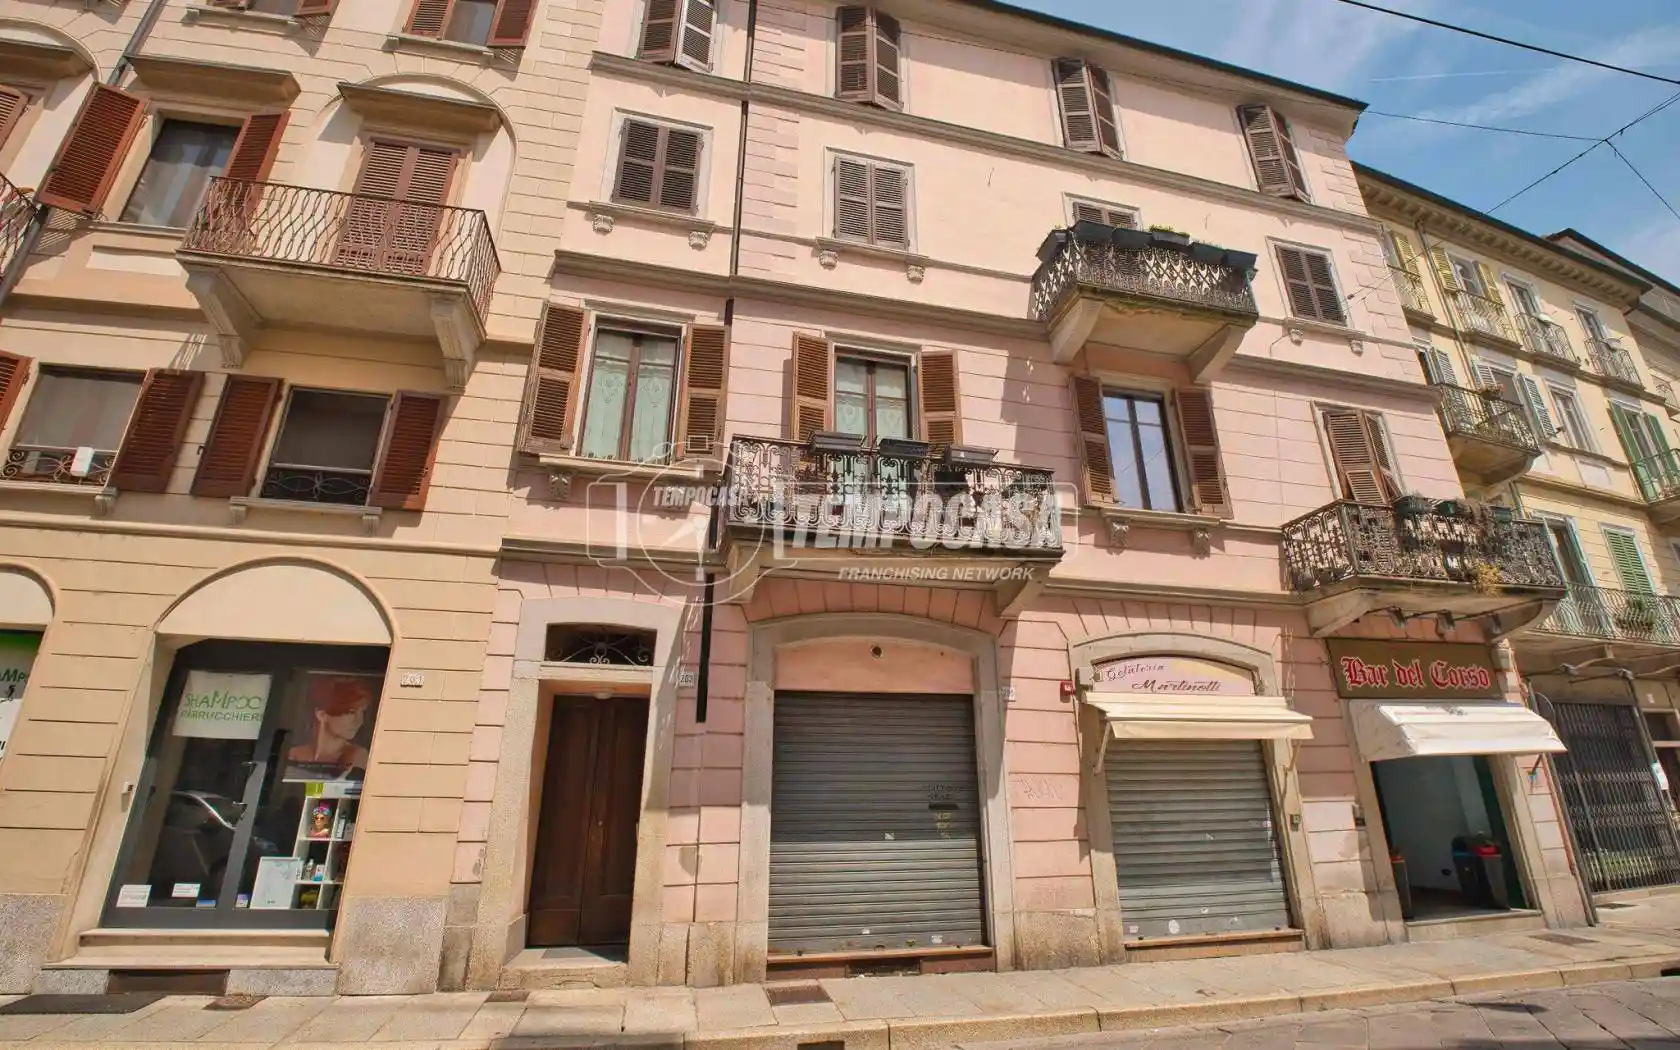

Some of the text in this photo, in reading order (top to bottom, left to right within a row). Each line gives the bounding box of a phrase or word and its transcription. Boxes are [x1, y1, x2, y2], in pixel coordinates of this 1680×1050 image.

[1340, 656, 1492, 690] Bar del Corso
